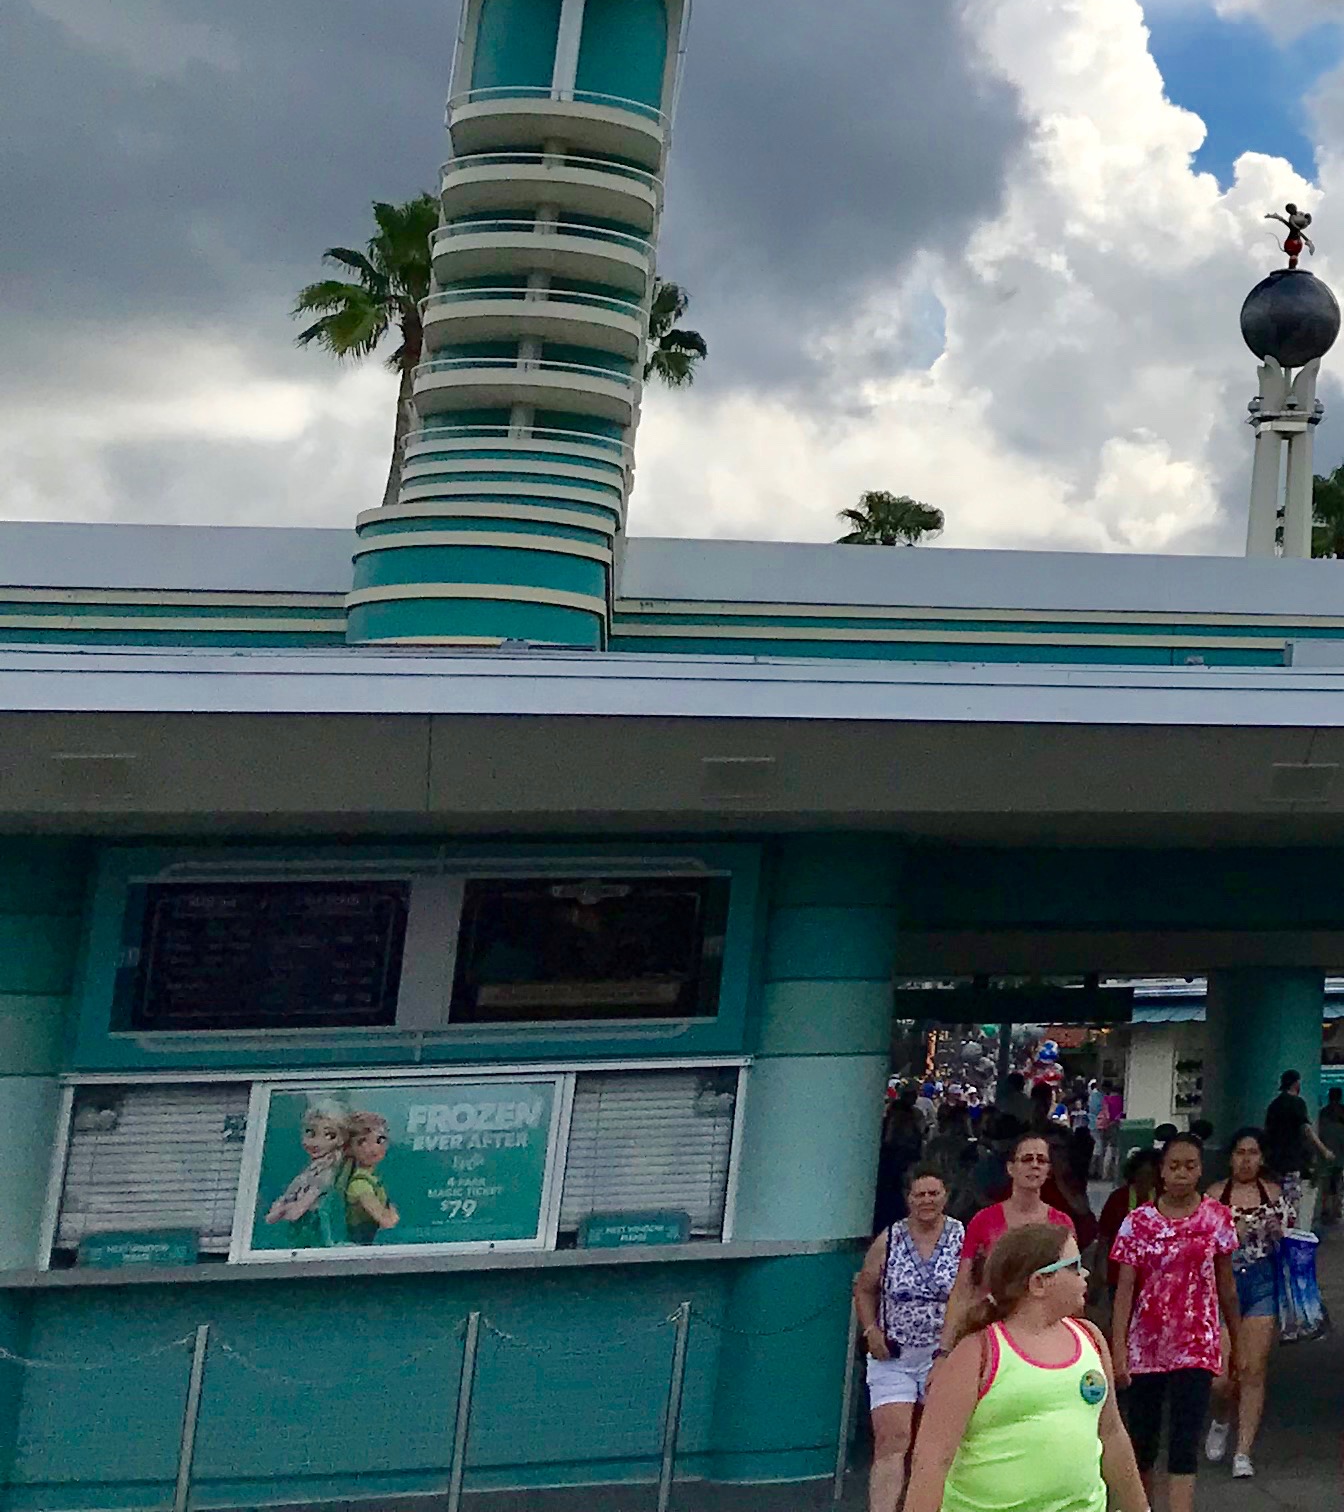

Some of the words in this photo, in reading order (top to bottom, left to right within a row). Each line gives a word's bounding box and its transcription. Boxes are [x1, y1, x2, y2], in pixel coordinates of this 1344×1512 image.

[406, 1100, 543, 1134] FROZEN
[413, 1135, 463, 1152] EVER
[466, 1130, 529, 1149] AFTER
[440, 1199, 477, 1219] $79
